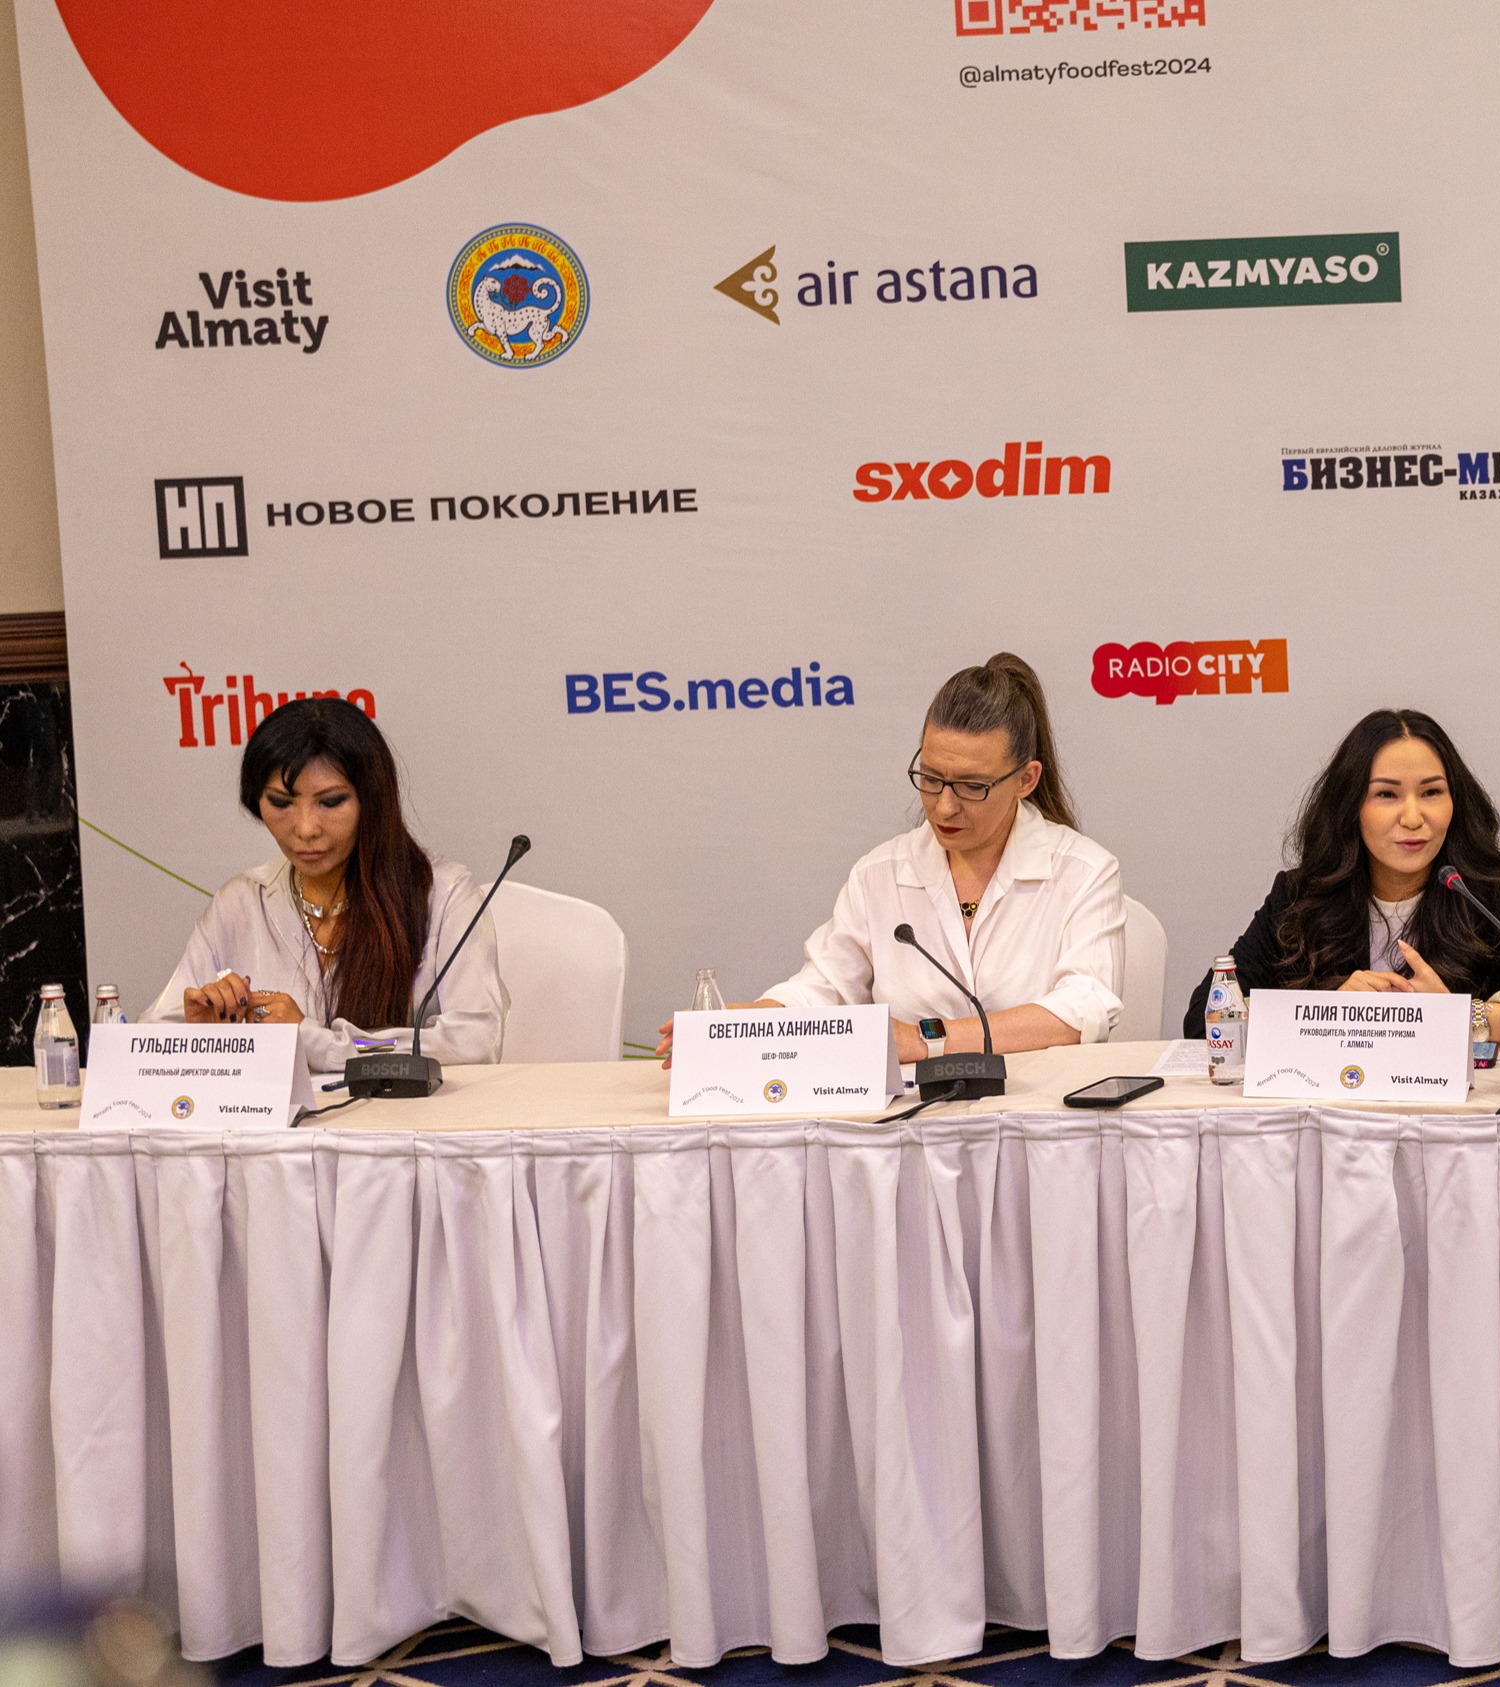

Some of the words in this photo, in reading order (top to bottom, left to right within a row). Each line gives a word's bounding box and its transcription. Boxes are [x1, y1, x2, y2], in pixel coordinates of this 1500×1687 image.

[960, 57, 1212, 88] @almatyfoodfest2024
[198, 268, 313, 311] Visit
[797, 260, 858, 307] air
[875, 260, 1039, 304] astana
[154, 309, 329, 355] Almaty
[853, 441, 1111, 503] sxodim
[267, 497, 415, 527] НОВОЕ
[430, 488, 698, 522] ПОКОЛЕНИЕ
[1109, 656, 1191, 679] RADIO
[1197, 653, 1265, 675] CITY
[565, 661, 855, 714] BES.media
[163, 662, 376, 747] Trib
[1295, 1005, 1337, 1021] ГАЛИЯ
[1341, 1005, 1423, 1023] ТОКСЕИТОВА
[709, 1022, 775, 1039] СВЕТЛАНА
[777, 1019, 853, 1037] ХАНИНАЕВА
[1299, 1028, 1346, 1037] РУКОВОДИТЕЛЬ
[1347, 1029, 1386, 1038] УПРАВЛЕНИЯ
[1387, 1029, 1416, 1038] ТУРИЗМА
[131, 1037, 188, 1055] ГУЛЬДЕН
[191, 1037, 255, 1054] ОСПАНОВА
[1207, 1040, 1234, 1049] ASSAY
[1340, 1040, 1346, 1048] Г.
[1347, 1040, 1374, 1049] АЛМАТЫ
[761, 1051, 798, 1061] ШЕФ-ПОВАР
[138, 1067, 180, 1077] ГЕНЕРАЛЬНЫЙ
[180, 1068, 210, 1077] ДИРЕКТОР
[210, 1068, 231, 1077] GLOBAL
[232, 1068, 242, 1077] AIR
[361, 1063, 410, 1076] BOSCH
[934, 1062, 986, 1076] BOSCH
[1390, 1075, 1412, 1085] Visit
[1413, 1076, 1449, 1087] Almaty
[813, 1087, 835, 1096] Visit
[835, 1086, 869, 1096] Almaty
[219, 1105, 240, 1113] Visit
[240, 1105, 273, 1115] Almaty
